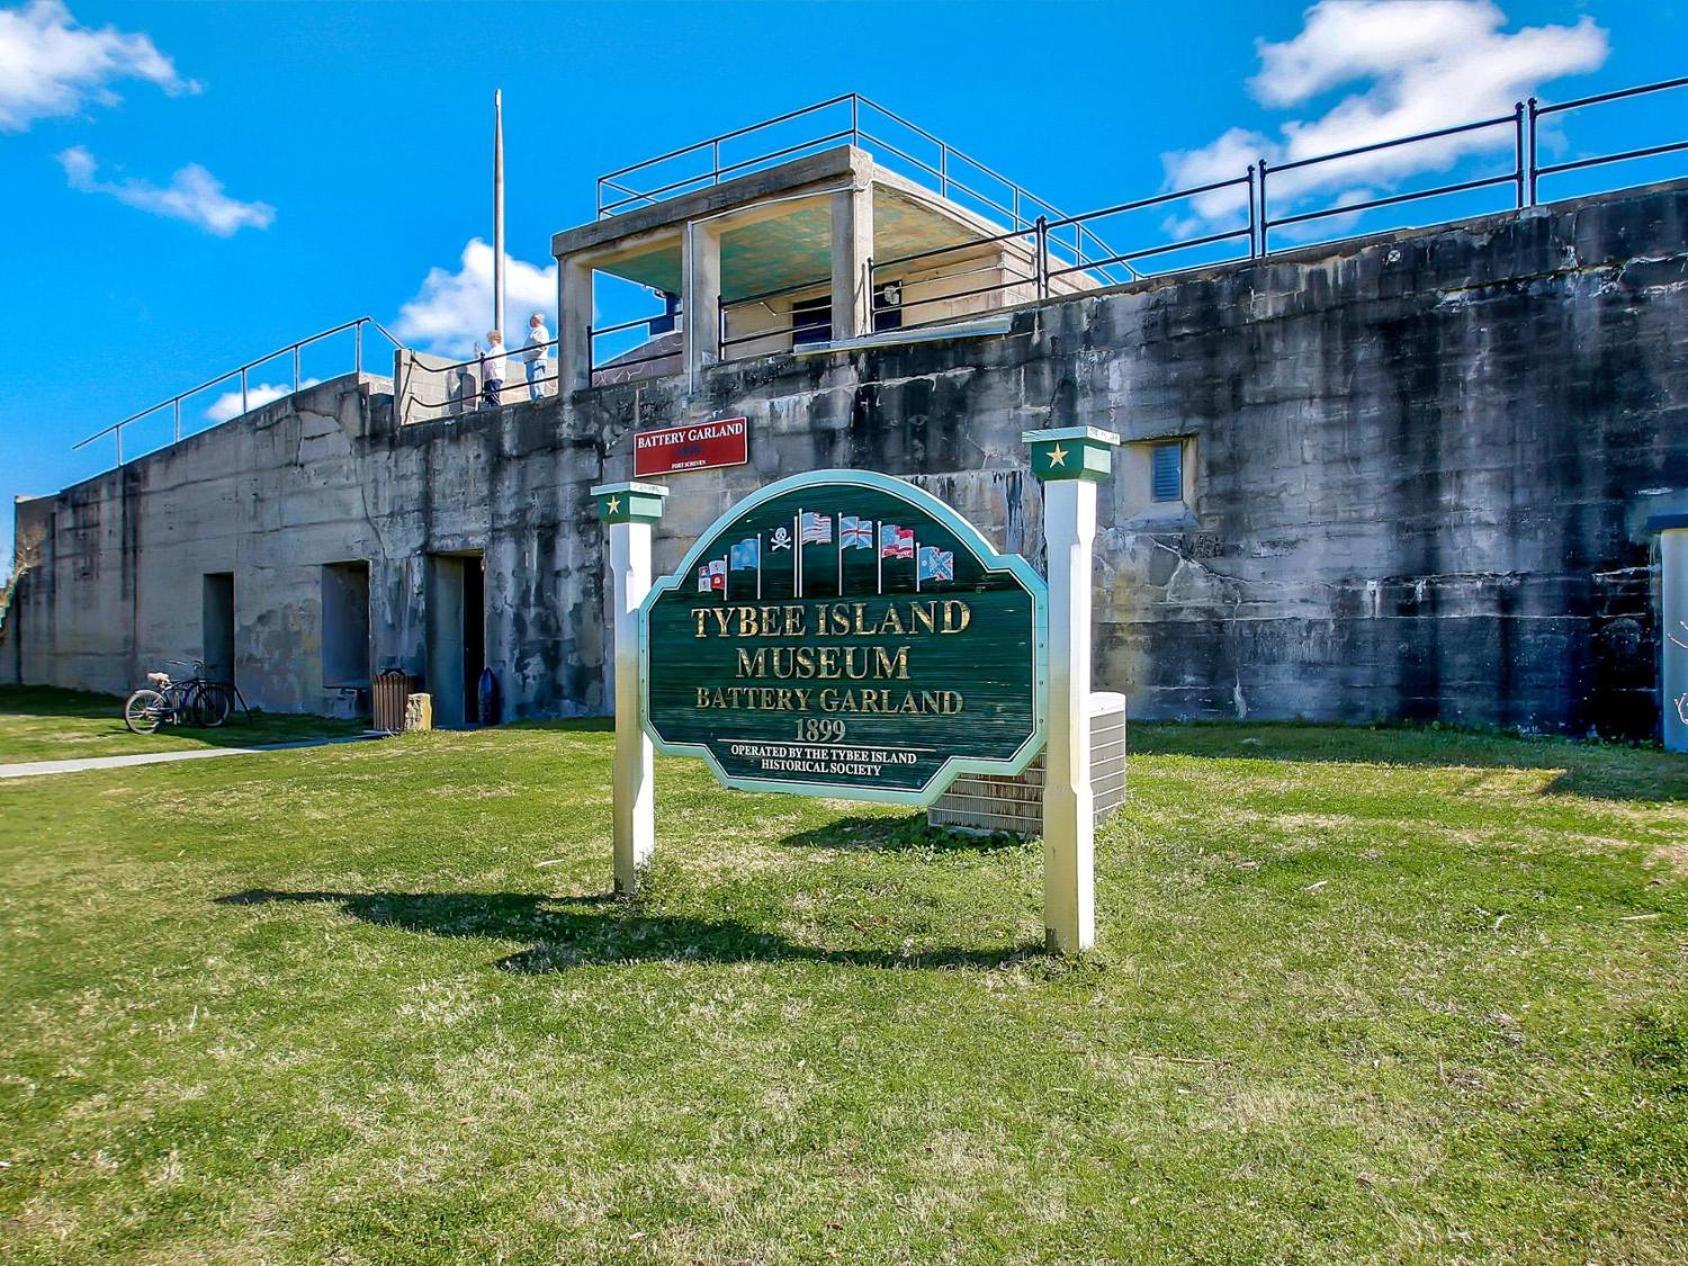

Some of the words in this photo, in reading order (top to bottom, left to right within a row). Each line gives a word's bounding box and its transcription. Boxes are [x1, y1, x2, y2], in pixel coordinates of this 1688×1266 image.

[638, 431, 686, 449] BATTERY
[688, 422, 743, 442] GARLAND
[691, 605, 806, 638] TYBEE
[815, 600, 971, 637] ISLAND
[735, 645, 912, 680] MUSEUM
[695, 686, 813, 711] BATTERY
[819, 688, 964, 715] GARLAND
[794, 718, 846, 743] 1899
[730, 744, 787, 758] OPERATED
[788, 747, 804, 759] BY
[804, 748, 829, 760] THE
[830, 749, 870, 762] TYBEE
[871, 751, 917, 765] ISLAND
[761, 758, 829, 773] HISTORICAL
[830, 762, 882, 776] SOCIETY
